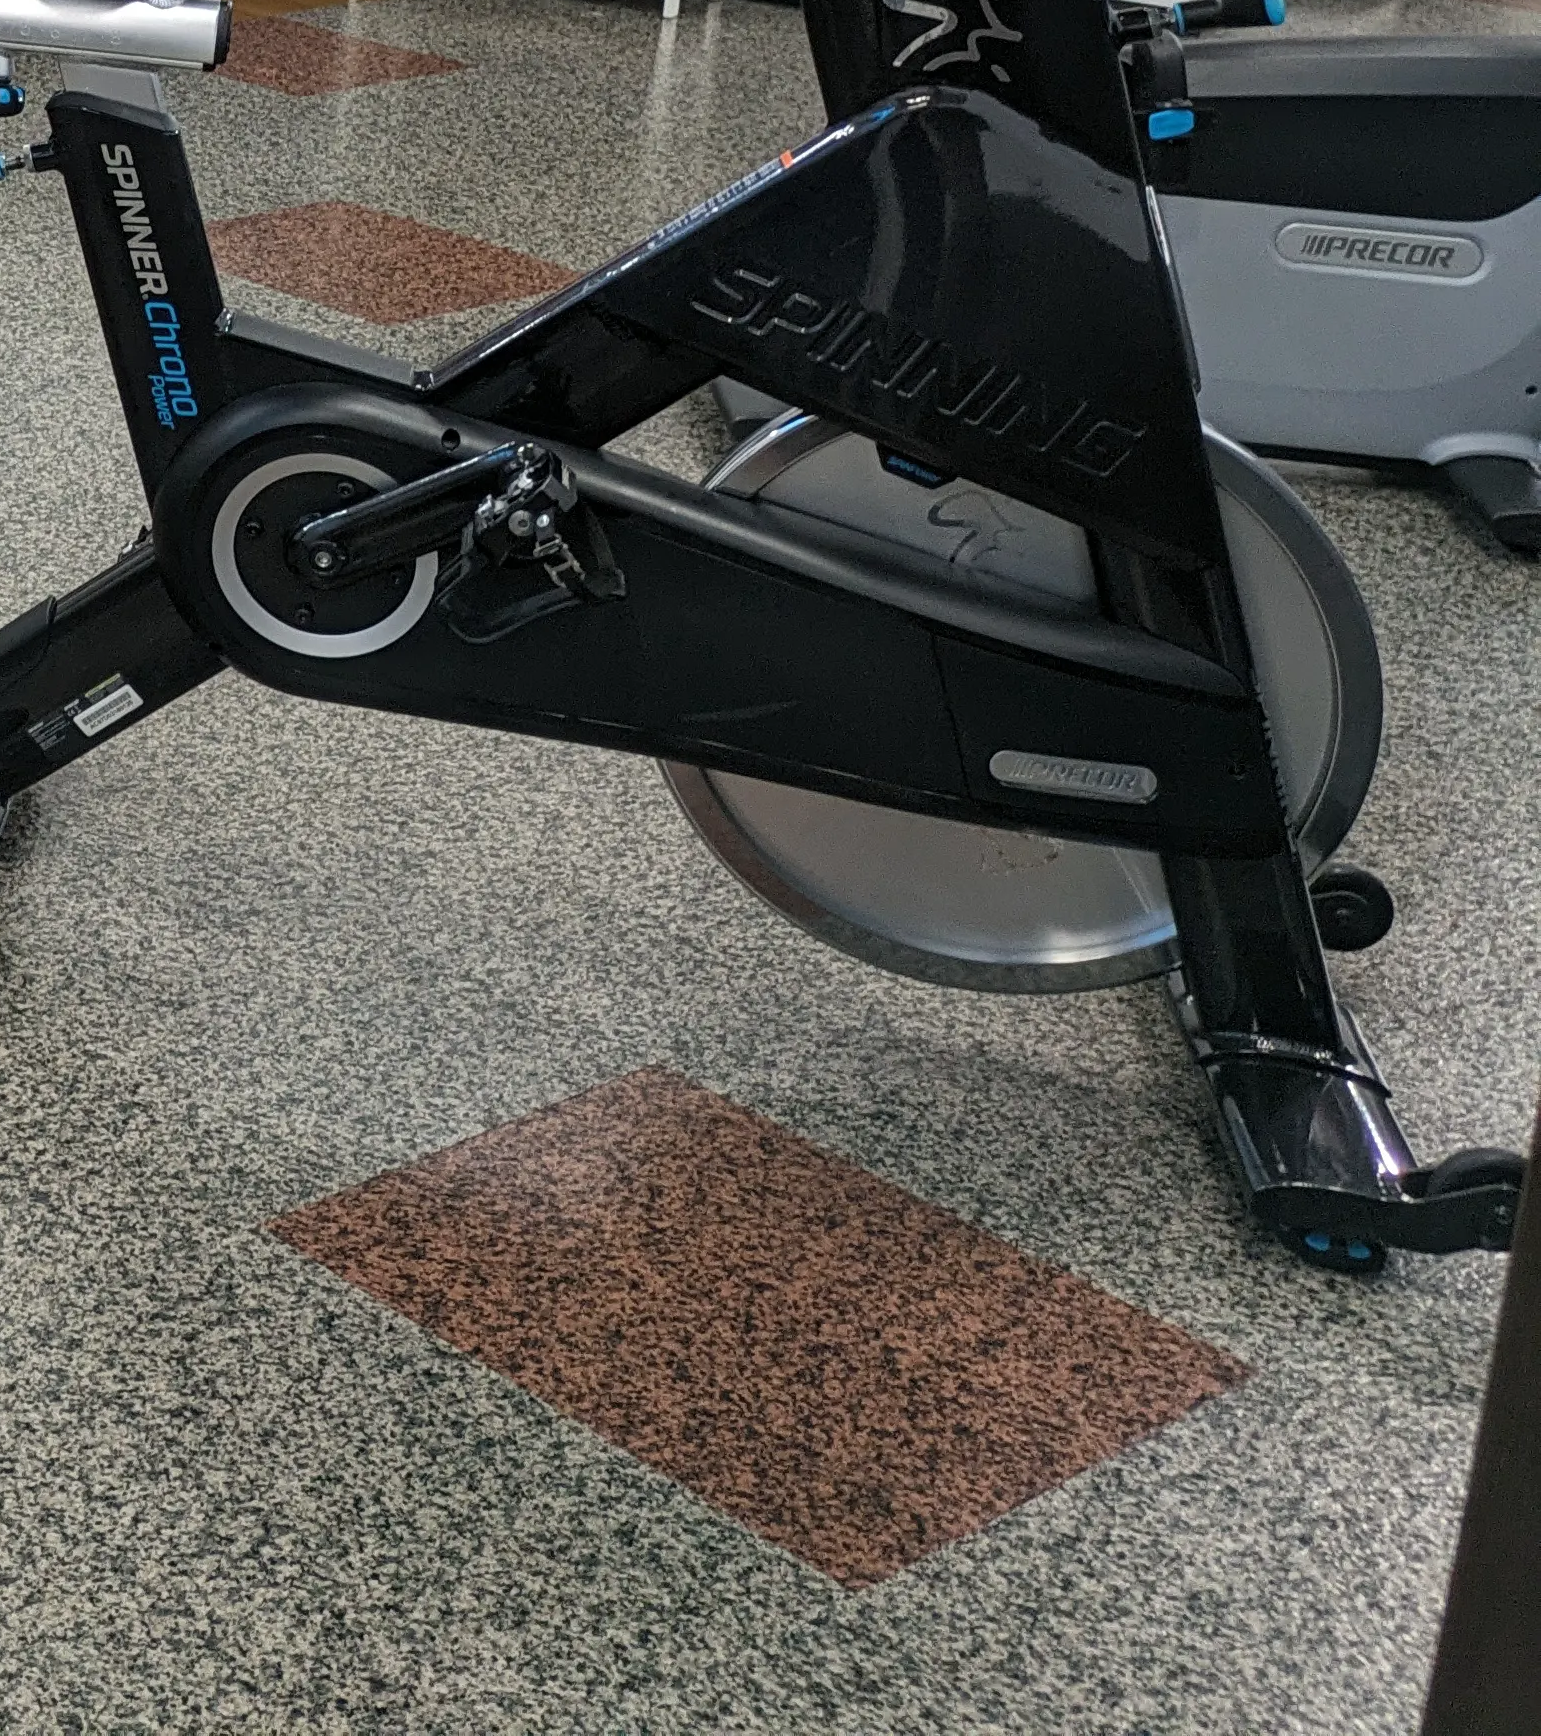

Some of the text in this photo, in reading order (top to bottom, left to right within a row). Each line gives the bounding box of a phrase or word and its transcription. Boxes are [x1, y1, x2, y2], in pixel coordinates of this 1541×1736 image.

[101, 143, 169, 299] SPINNER
[1323, 236, 1455, 269] PRECOR
[691, 268, 1147, 478] SPINNING
